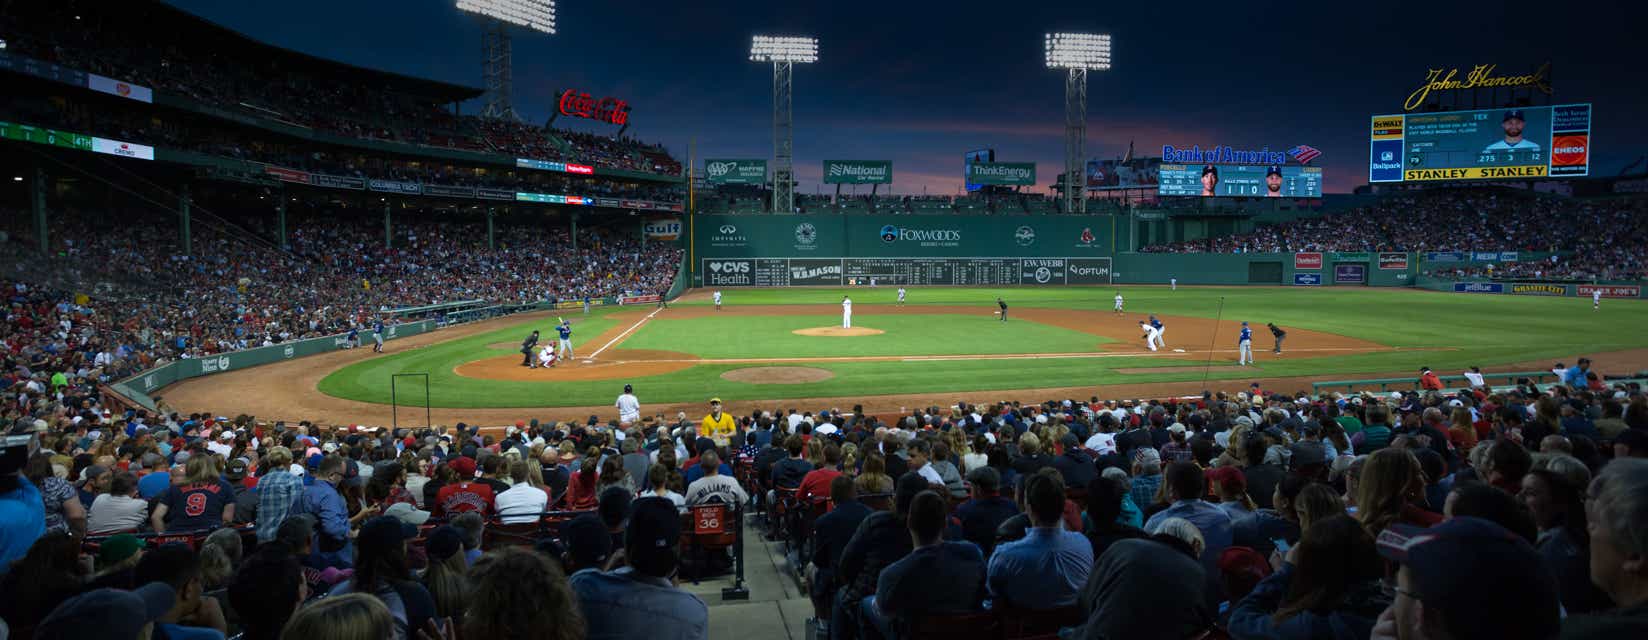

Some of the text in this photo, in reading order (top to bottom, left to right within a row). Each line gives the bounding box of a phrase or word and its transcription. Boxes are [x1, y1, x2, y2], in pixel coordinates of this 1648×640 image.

[1404, 60, 1552, 111] John Hancock
[560, 89, 628, 124] Coca-Cola
[1163, 145, 1285, 164] Bank of America
[1554, 146, 1585, 154] ENEOS
[842, 164, 887, 176] National
[974, 166, 1031, 178] ThinkEnergy
[1408, 169, 1468, 180] STANLEY
[1481, 166, 1544, 179] STANLEY
[1251, 186, 1257, 194] 0
[645, 223, 680, 233] Gulf
[900, 228, 960, 241] FOXWOODS
[723, 262, 749, 273] CVS
[1079, 267, 1108, 276] OPTUM
[711, 273, 750, 285] Health
[1465, 282, 1492, 292] jetBlue
[1579, 287, 1610, 295] TRAER
[697, 483, 731, 498] WILLIAMS
[185, 492, 207, 517] 9
[699, 518, 719, 529] 36
